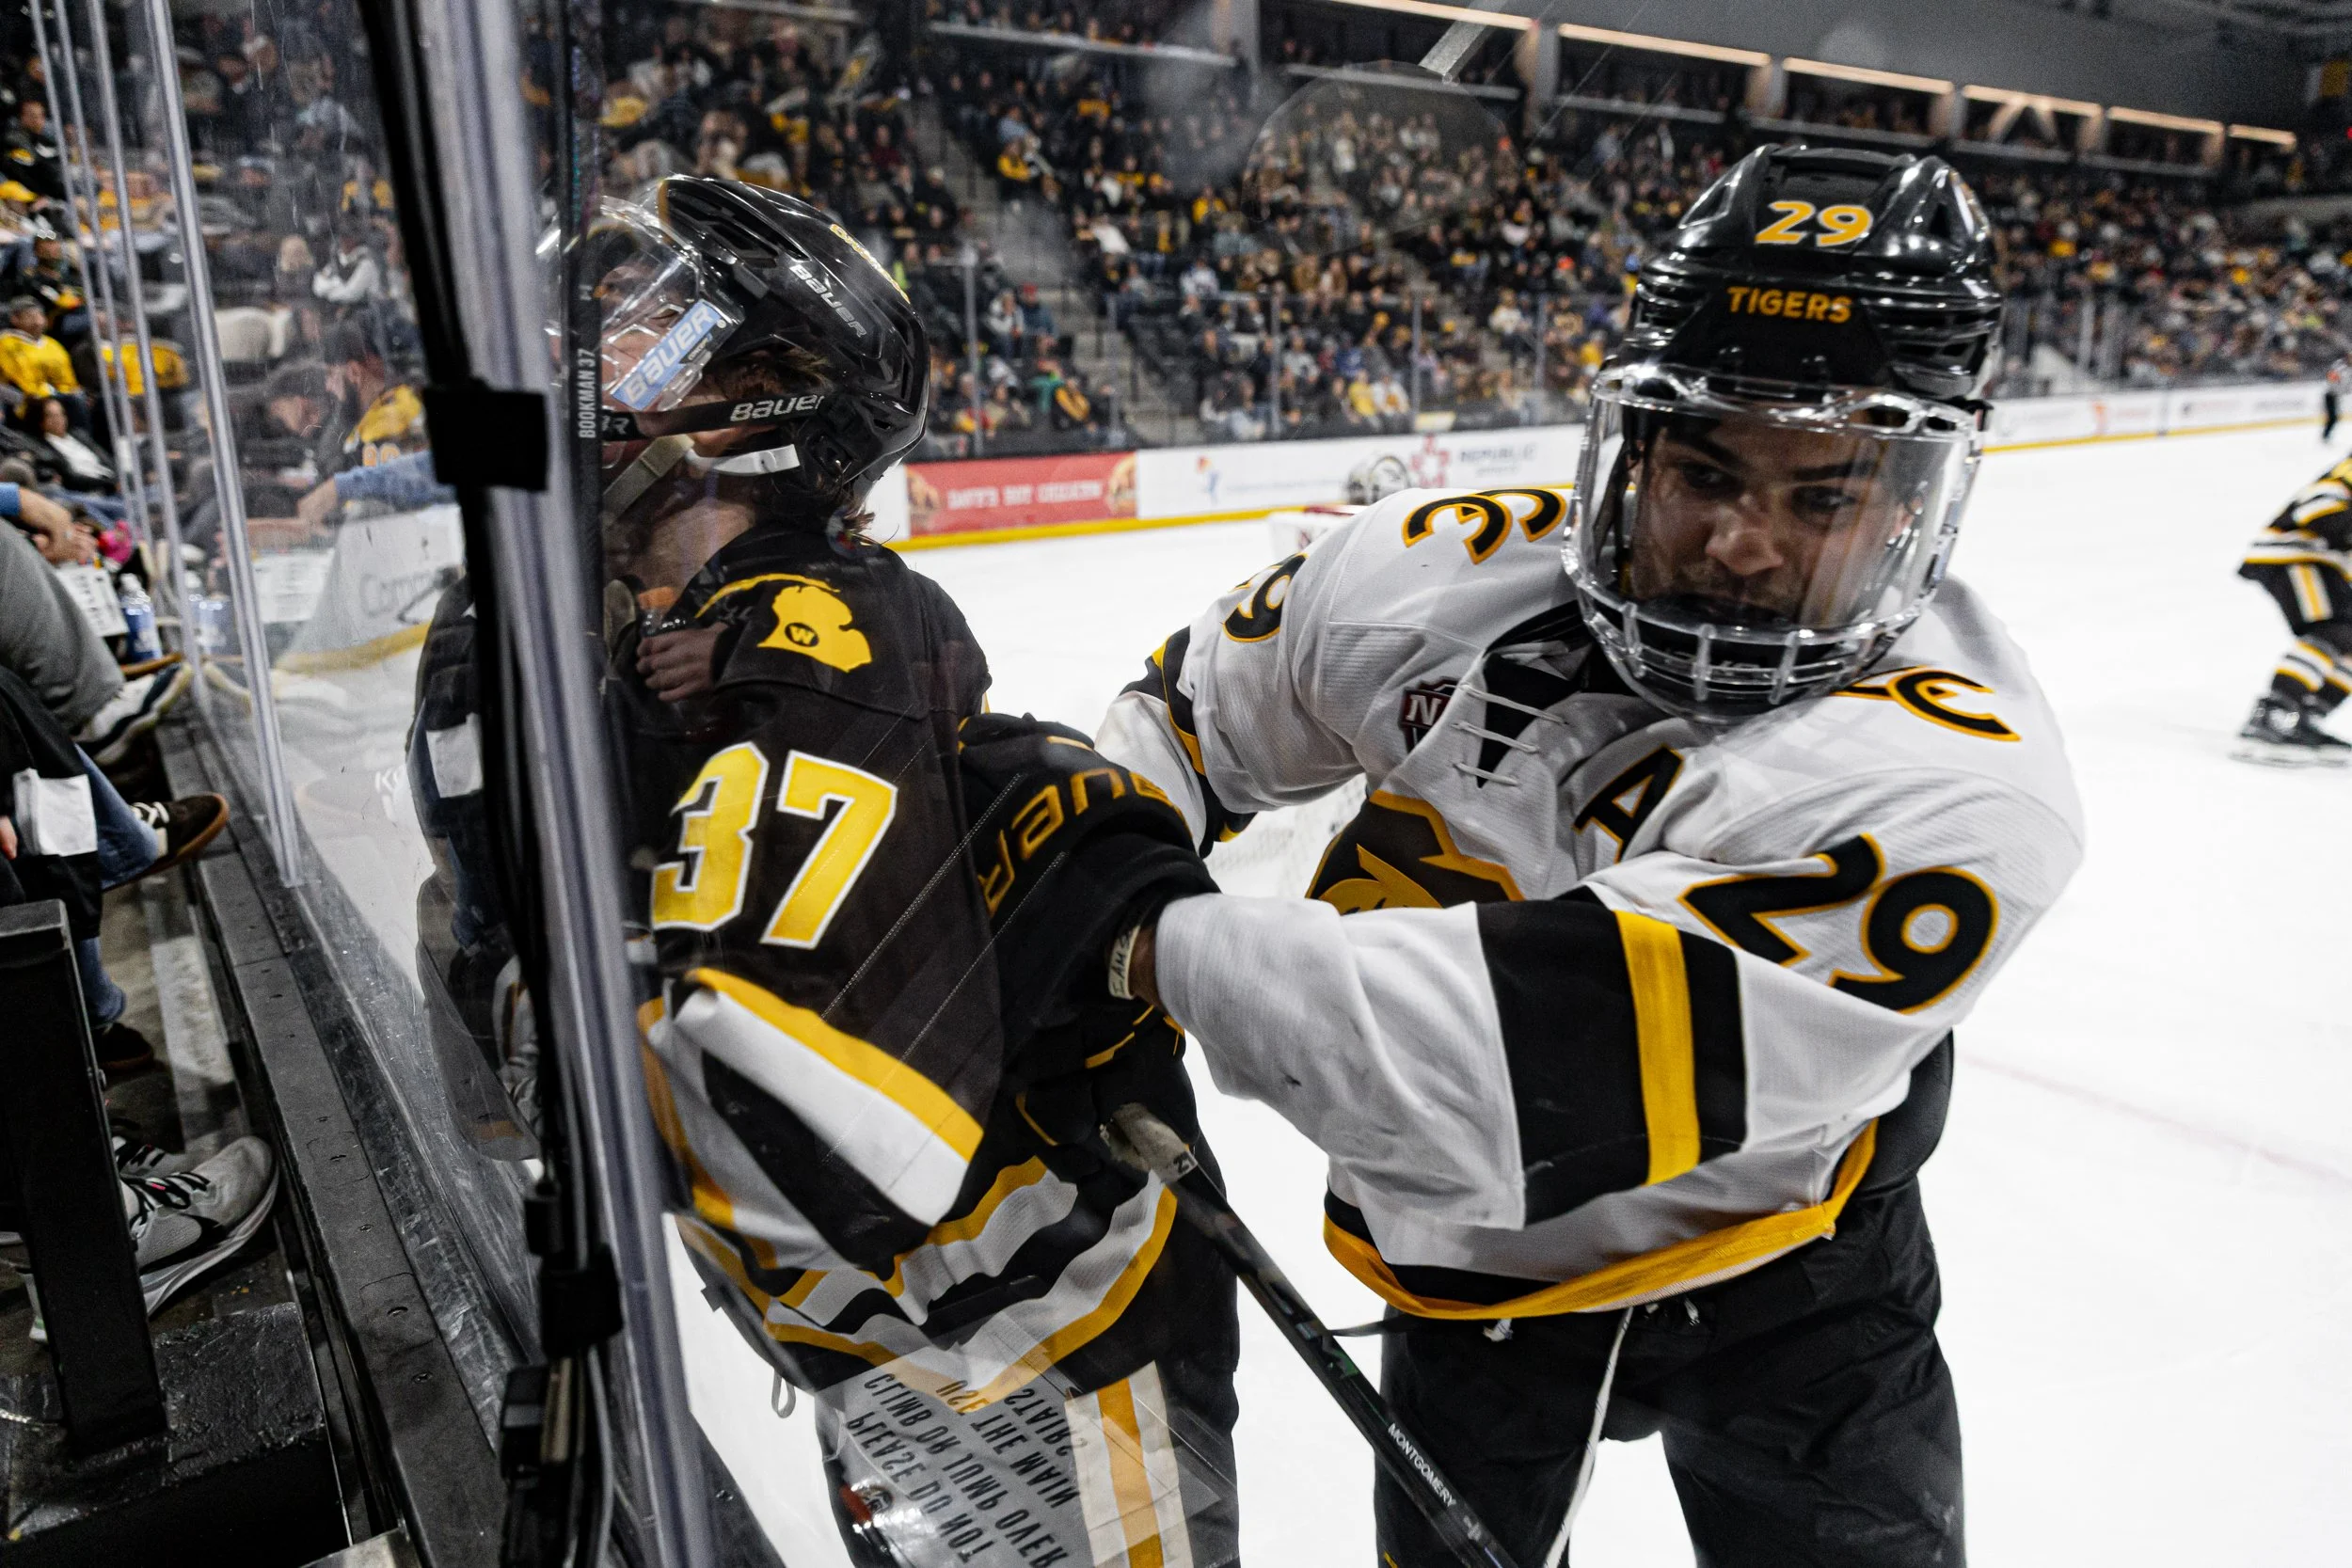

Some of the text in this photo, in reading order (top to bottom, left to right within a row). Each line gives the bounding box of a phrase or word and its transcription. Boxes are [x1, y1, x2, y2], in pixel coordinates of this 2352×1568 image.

[1755, 199, 1874, 247] 29
[788, 263, 867, 339] BAUER
[1726, 285, 1853, 325] TIGERS
[579, 349, 596, 438] BOOKMAN 37
[623, 305, 715, 404] BAUER
[791, 625, 817, 646] W
[651, 741, 898, 950] 37
[1572, 744, 1684, 864] A
[1677, 832, 2000, 1015] 29
[1388, 1422, 1457, 1507] MONTGOMERY
